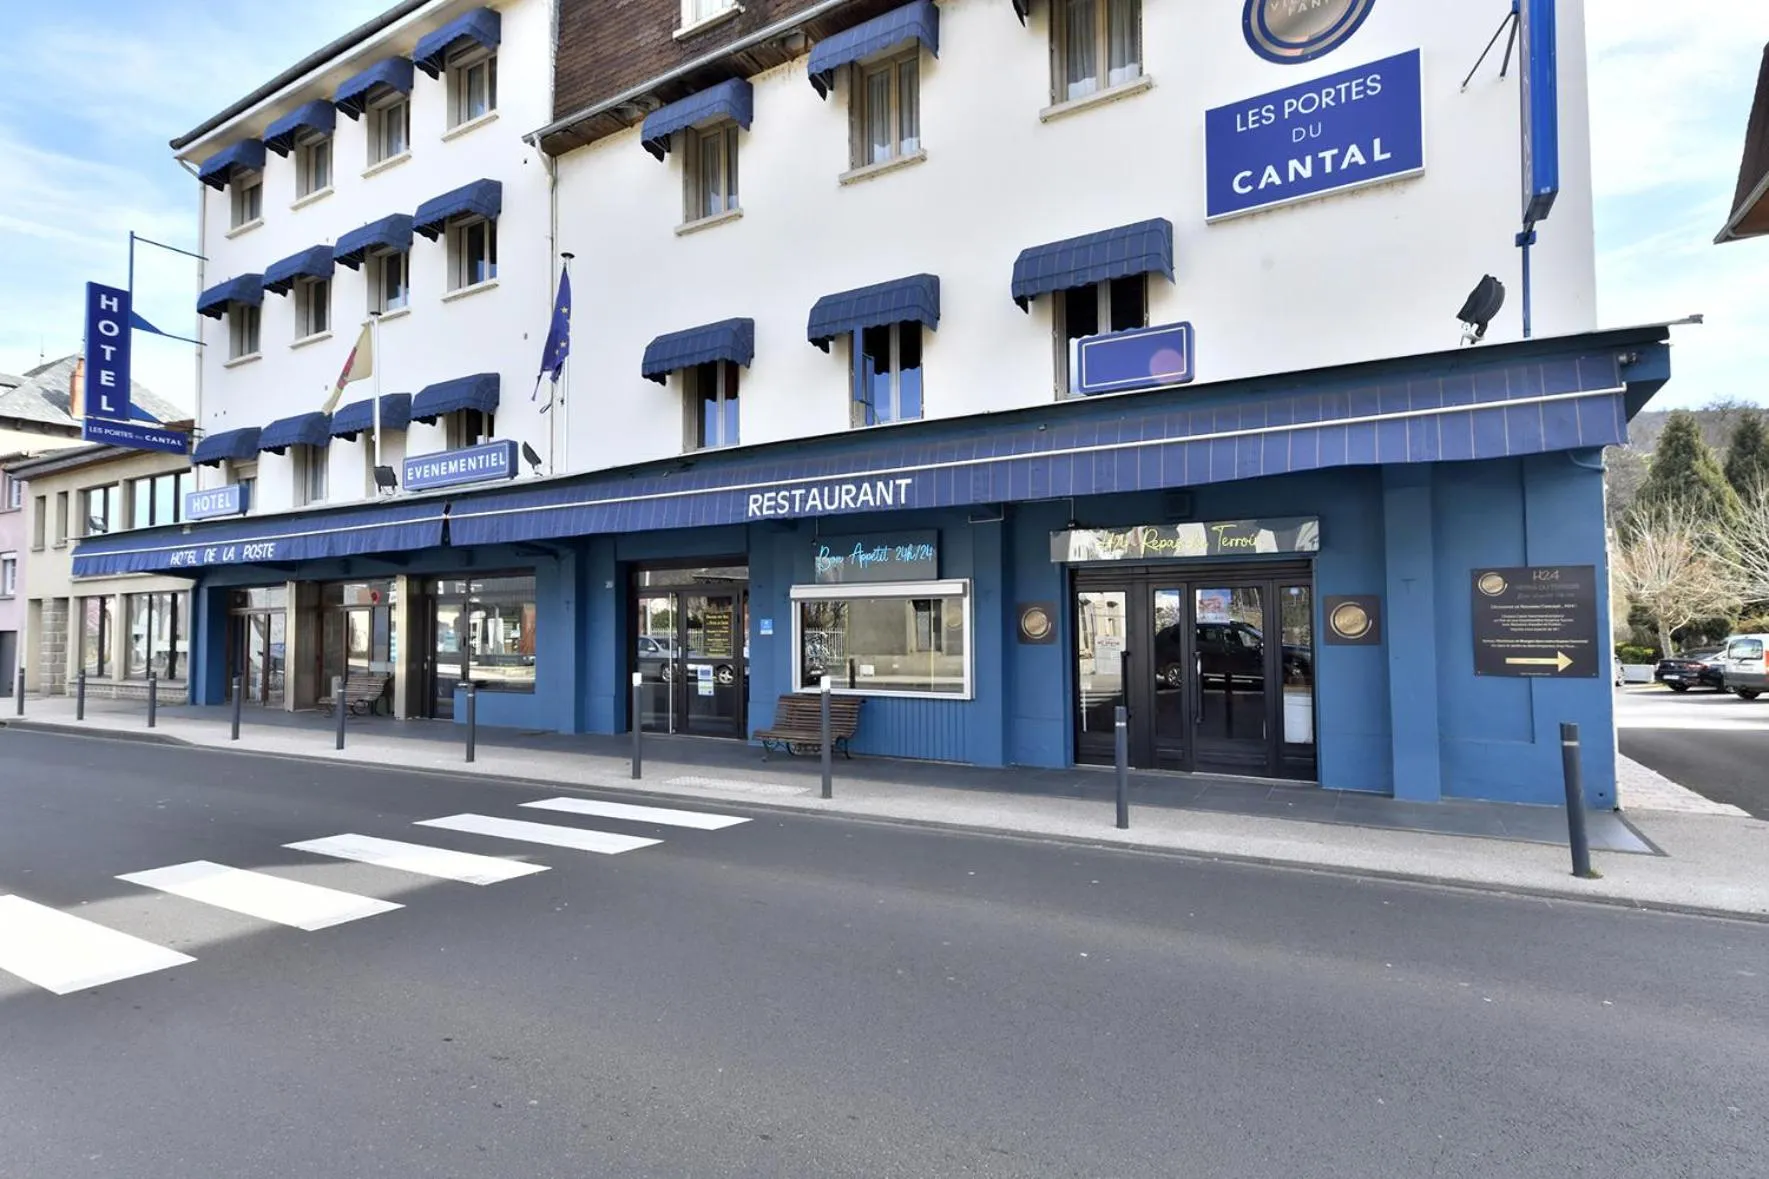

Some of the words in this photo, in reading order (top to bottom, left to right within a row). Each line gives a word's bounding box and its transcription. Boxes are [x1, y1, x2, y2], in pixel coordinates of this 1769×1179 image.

[1236, 104, 1276, 132] LES
[1284, 74, 1382, 119] PORTES
[1292, 122, 1322, 142] DU
[1232, 137, 1392, 194] CANTAL
[98, 294, 119, 412] HOTEL
[89, 425, 103, 434] LES
[104, 428, 134, 439] PORTES
[144, 434, 182, 447] CANTAL
[407, 452, 505, 480] EVENEMENTIEL
[192, 492, 231, 513] HOTEL
[748, 478, 912, 517] RESTAURANT
[170, 550, 197, 566] HOTEL
[204, 547, 217, 563] DE
[222, 546, 236, 561] LA
[242, 543, 276, 560] POSTE
